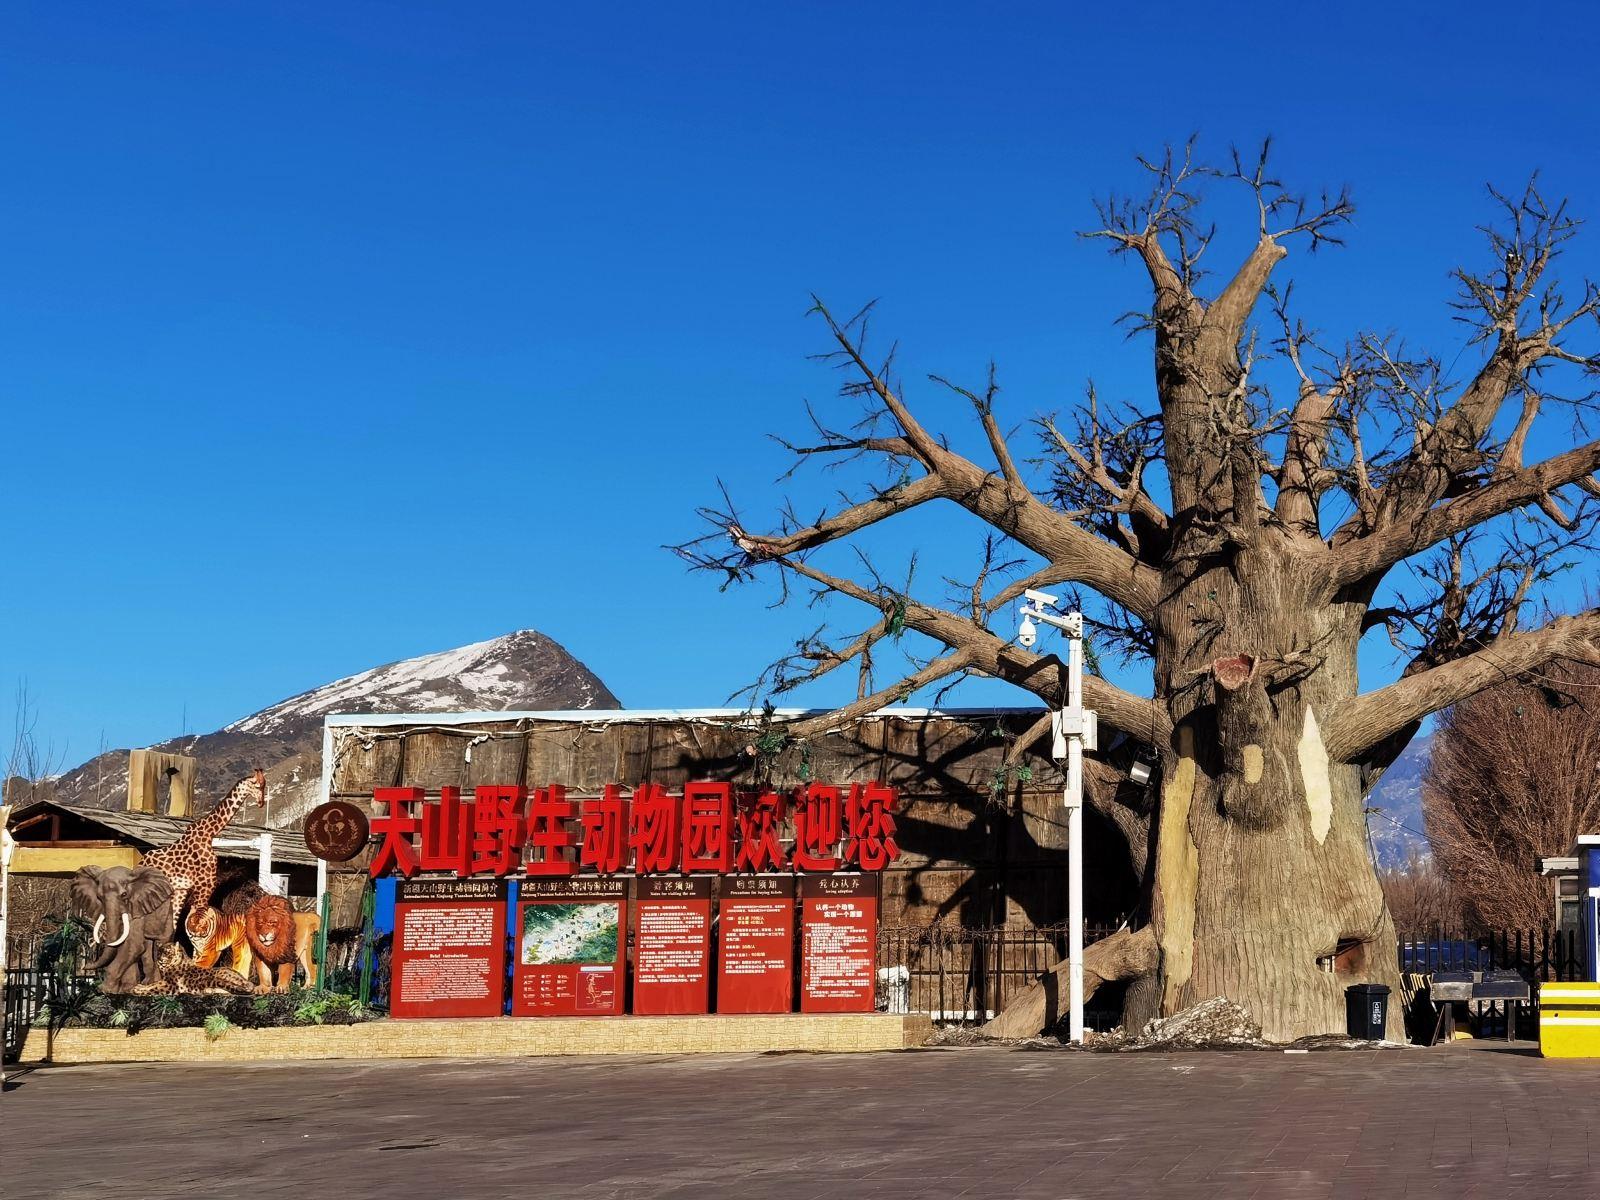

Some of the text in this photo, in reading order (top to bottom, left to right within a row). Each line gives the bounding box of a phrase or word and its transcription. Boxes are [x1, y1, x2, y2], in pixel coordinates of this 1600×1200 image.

[369, 782, 901, 877] 天山野生动物园欢迎您
[736, 879, 777, 890] 购票须知
[819, 878, 860, 889] 爱心认养
